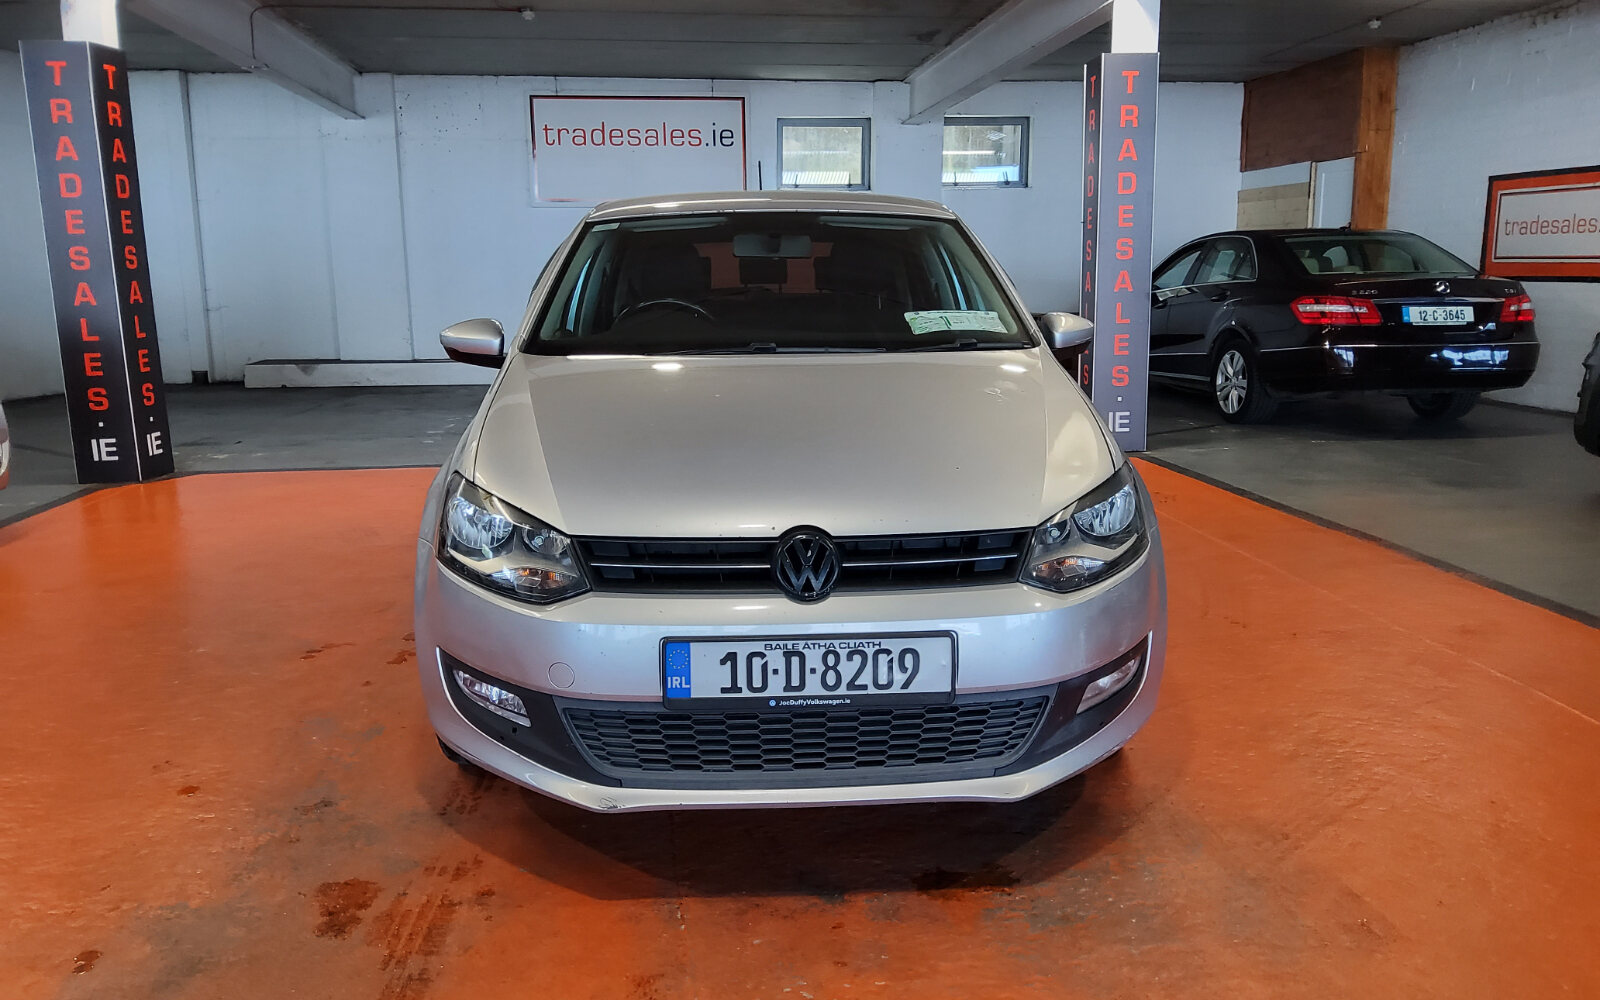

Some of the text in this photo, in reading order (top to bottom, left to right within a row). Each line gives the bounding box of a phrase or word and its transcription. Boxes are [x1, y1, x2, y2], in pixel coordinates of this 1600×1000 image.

[542, 121, 735, 147] tradesales.ie
[1418, 309, 1466, 321] 12-C-3645
[764, 643, 800, 651] BAILE
[838, 641, 882, 650] CLIATH
[667, 676, 690, 689] IRL
